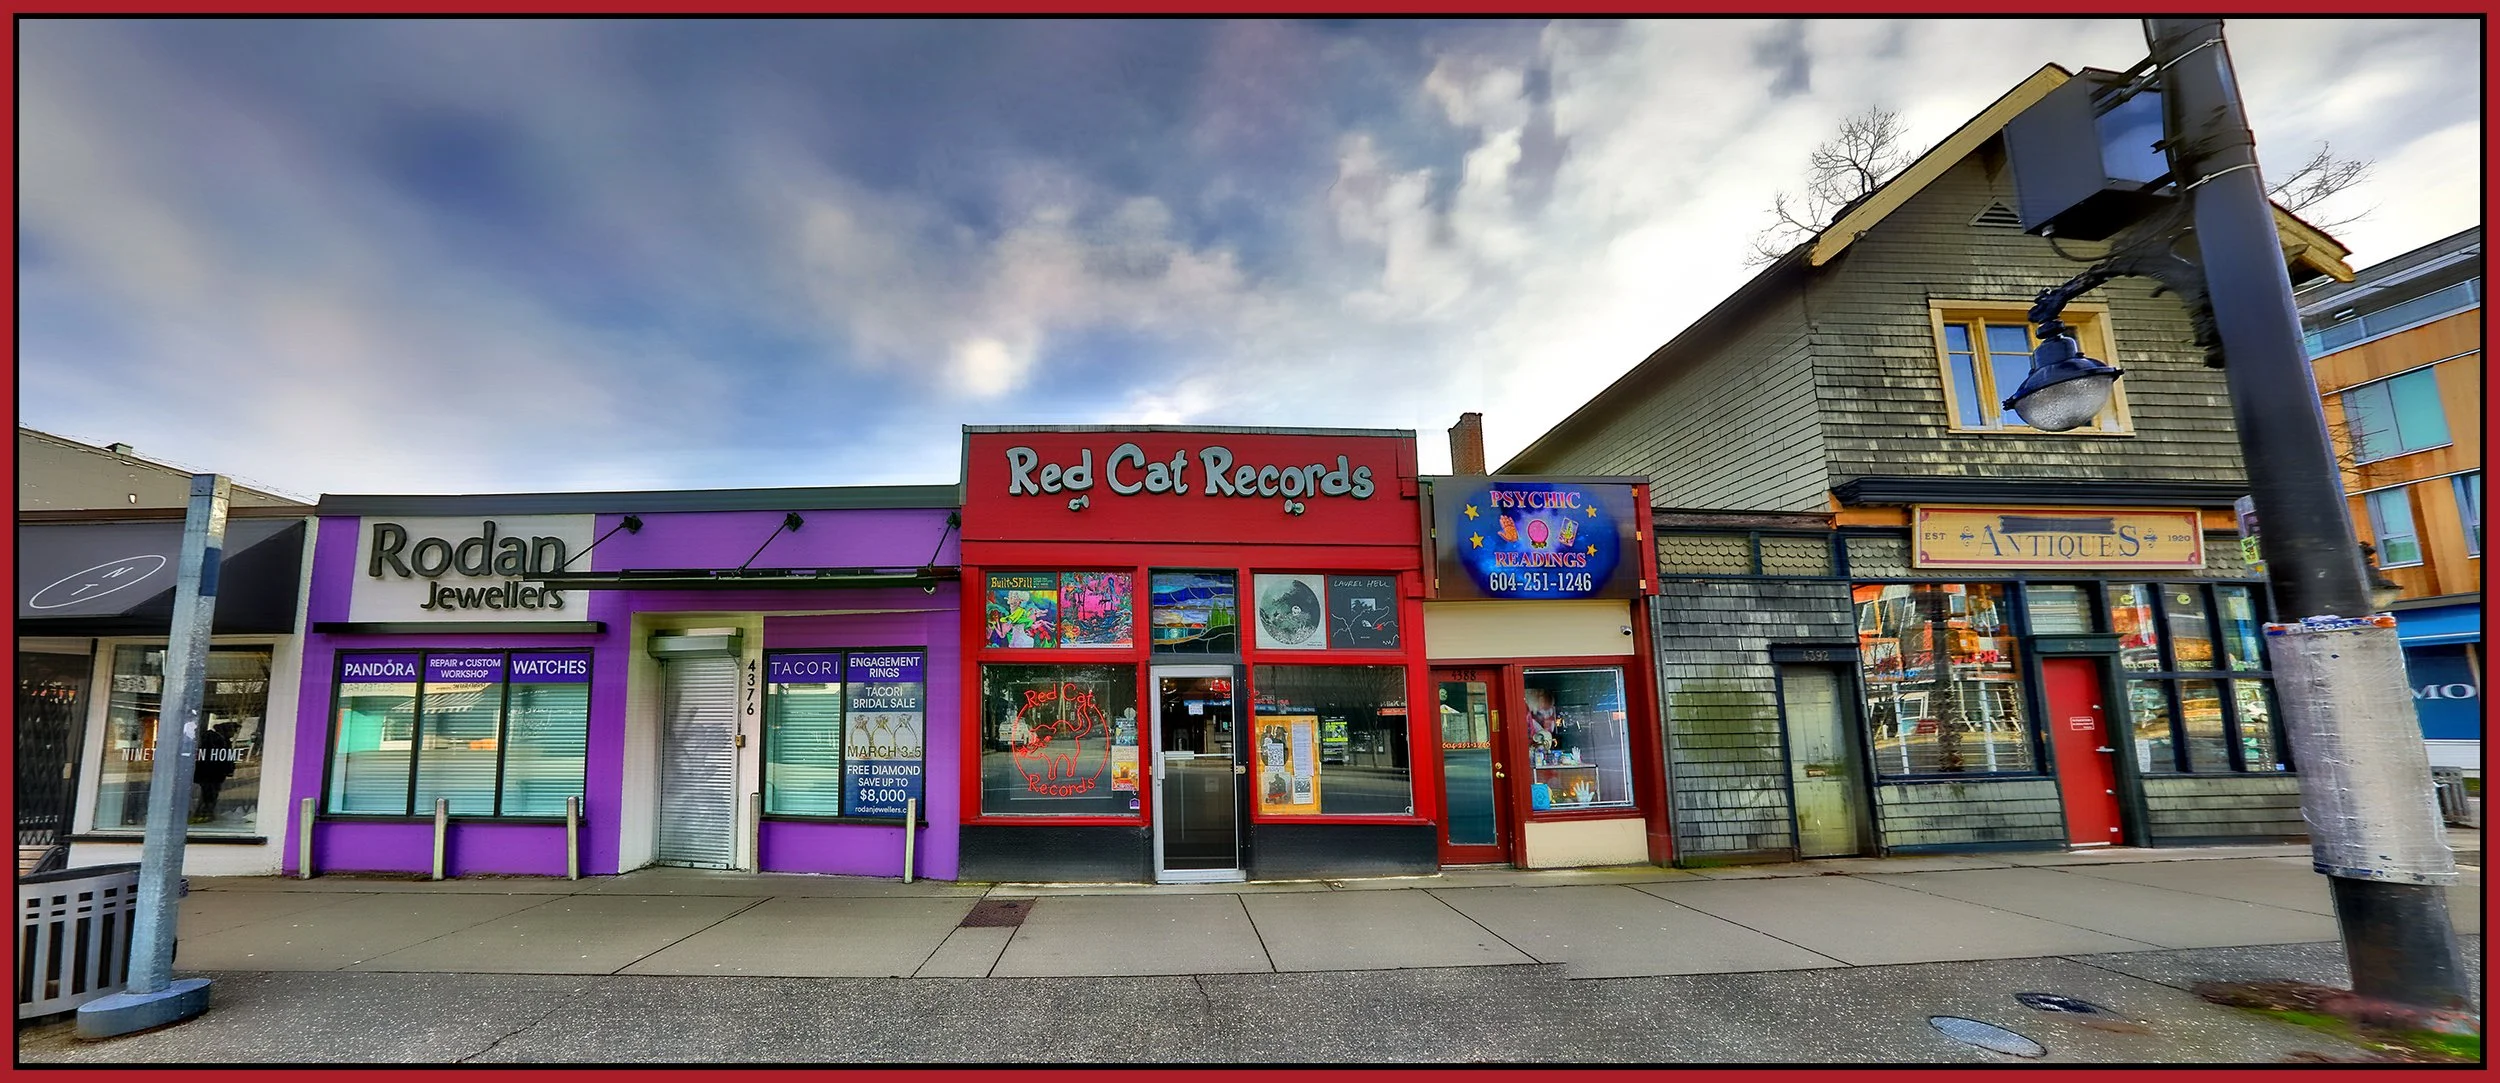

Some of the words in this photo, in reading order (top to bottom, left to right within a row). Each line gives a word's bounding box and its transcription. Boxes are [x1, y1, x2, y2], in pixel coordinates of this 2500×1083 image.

[1006, 446, 1095, 497] Red
[1106, 443, 1189, 496] Cat
[1199, 446, 1376, 500] Records
[1489, 490, 1581, 510] PSYCHIC
[1924, 533, 1946, 541] EST
[1975, 524, 2141, 558] ANTIQUES
[2167, 534, 2191, 543] 1920
[368, 520, 567, 579] Rodan
[1493, 552, 1588, 569] READINGS
[1489, 572, 1593, 593] 604-251-1246
[420, 581, 566, 611] Jewellers
[850, 656, 920, 668] ENGAGEMENT
[1802, 650, 1830, 661] 4392
[429, 659, 458, 668] REPAIR
[465, 658, 501, 668] CUSTOM
[513, 660, 587, 675] WATCHES
[771, 662, 839, 675] TACORI
[441, 669, 489, 679] WORKSHOP
[869, 667, 900, 678] RINGS
[1451, 670, 1477, 681] 4388
[865, 686, 903, 697] TACORI
[1024, 684, 1058, 708] Red
[1062, 683, 1094, 708] Cat
[853, 698, 888, 708] BRIDAL
[890, 698, 916, 708] SALE
[121, 748, 206, 761] NINETN
[210, 748, 245, 761] HOME
[847, 746, 897, 758] MARCH
[901, 745, 921, 758] 3-5
[847, 765, 870, 775] FREE
[871, 765, 921, 776] DIAMOND
[858, 777, 880, 787] SAVE
[882, 777, 894, 786] UP
[896, 777, 909, 787] TO
[1027, 773, 1097, 797] Records
[859, 788, 906, 804] $8,000
